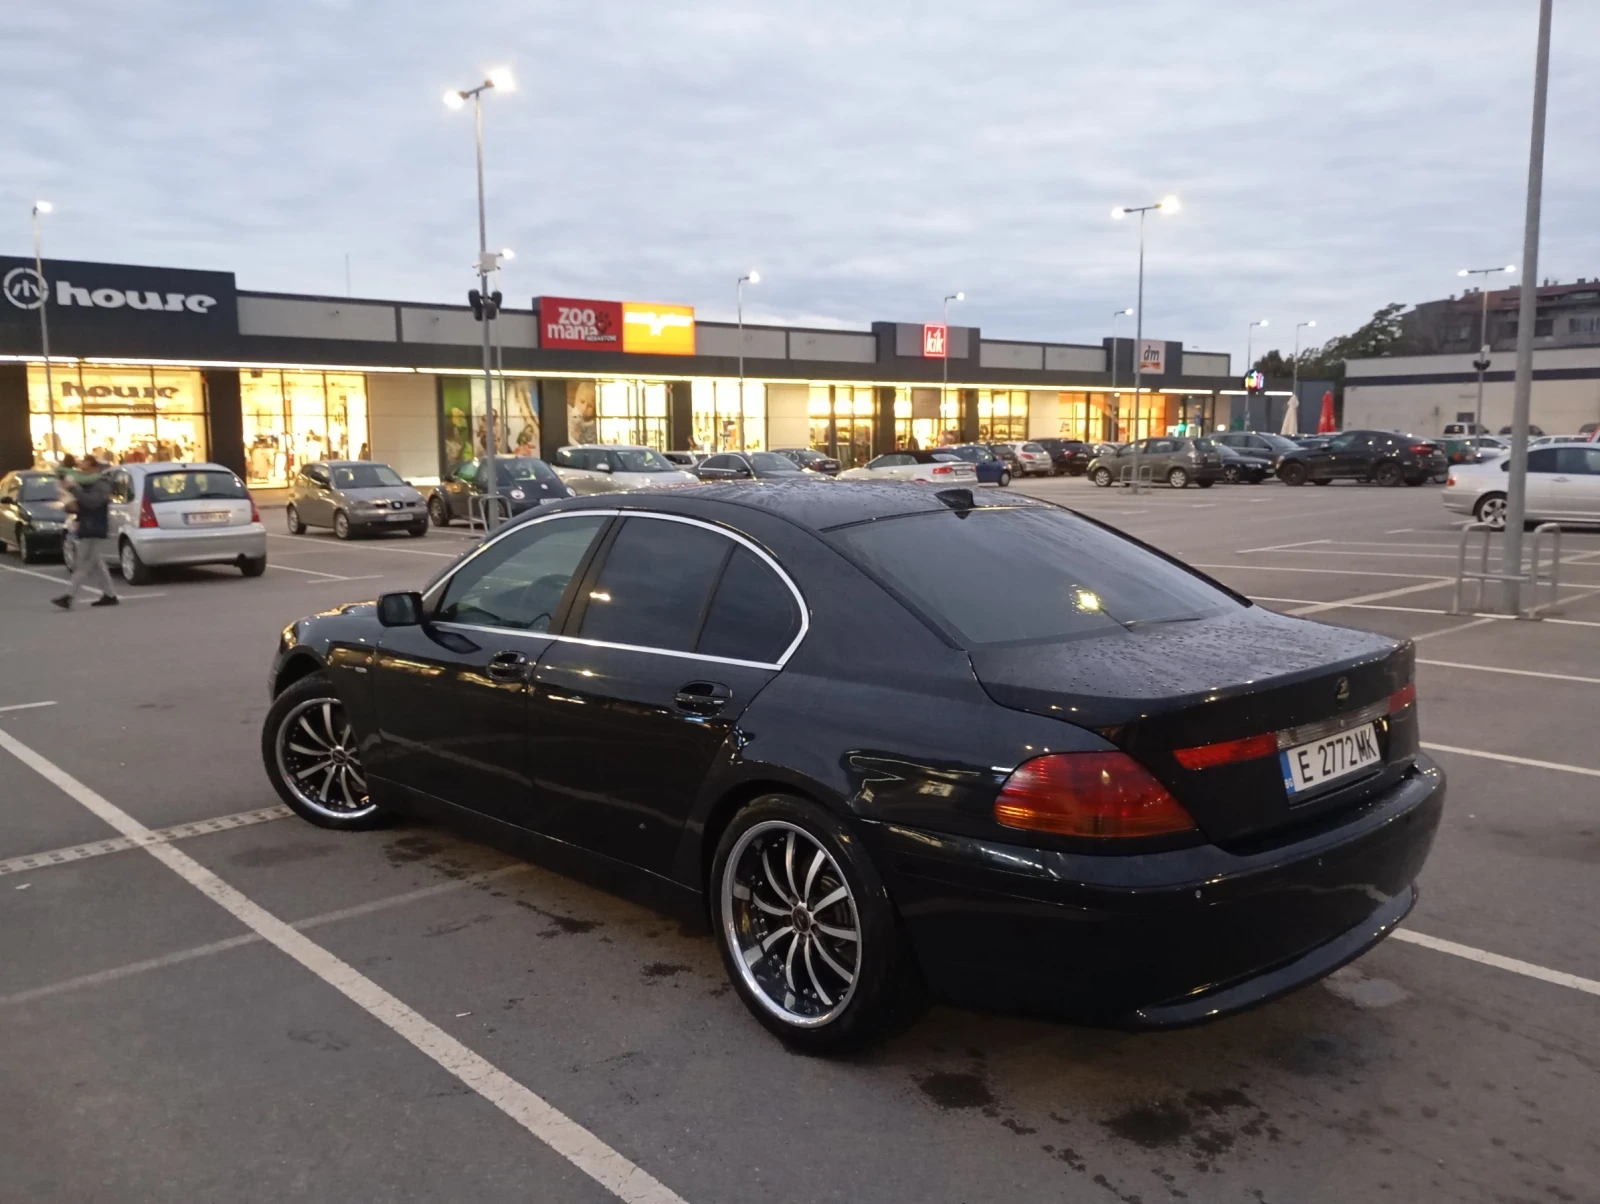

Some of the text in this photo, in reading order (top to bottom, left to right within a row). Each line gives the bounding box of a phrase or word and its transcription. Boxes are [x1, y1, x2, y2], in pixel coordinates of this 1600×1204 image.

[56, 281, 217, 314] house
[547, 323, 598, 340] mania
[1143, 346, 1160, 362] dm
[1297, 750, 1314, 783] E
